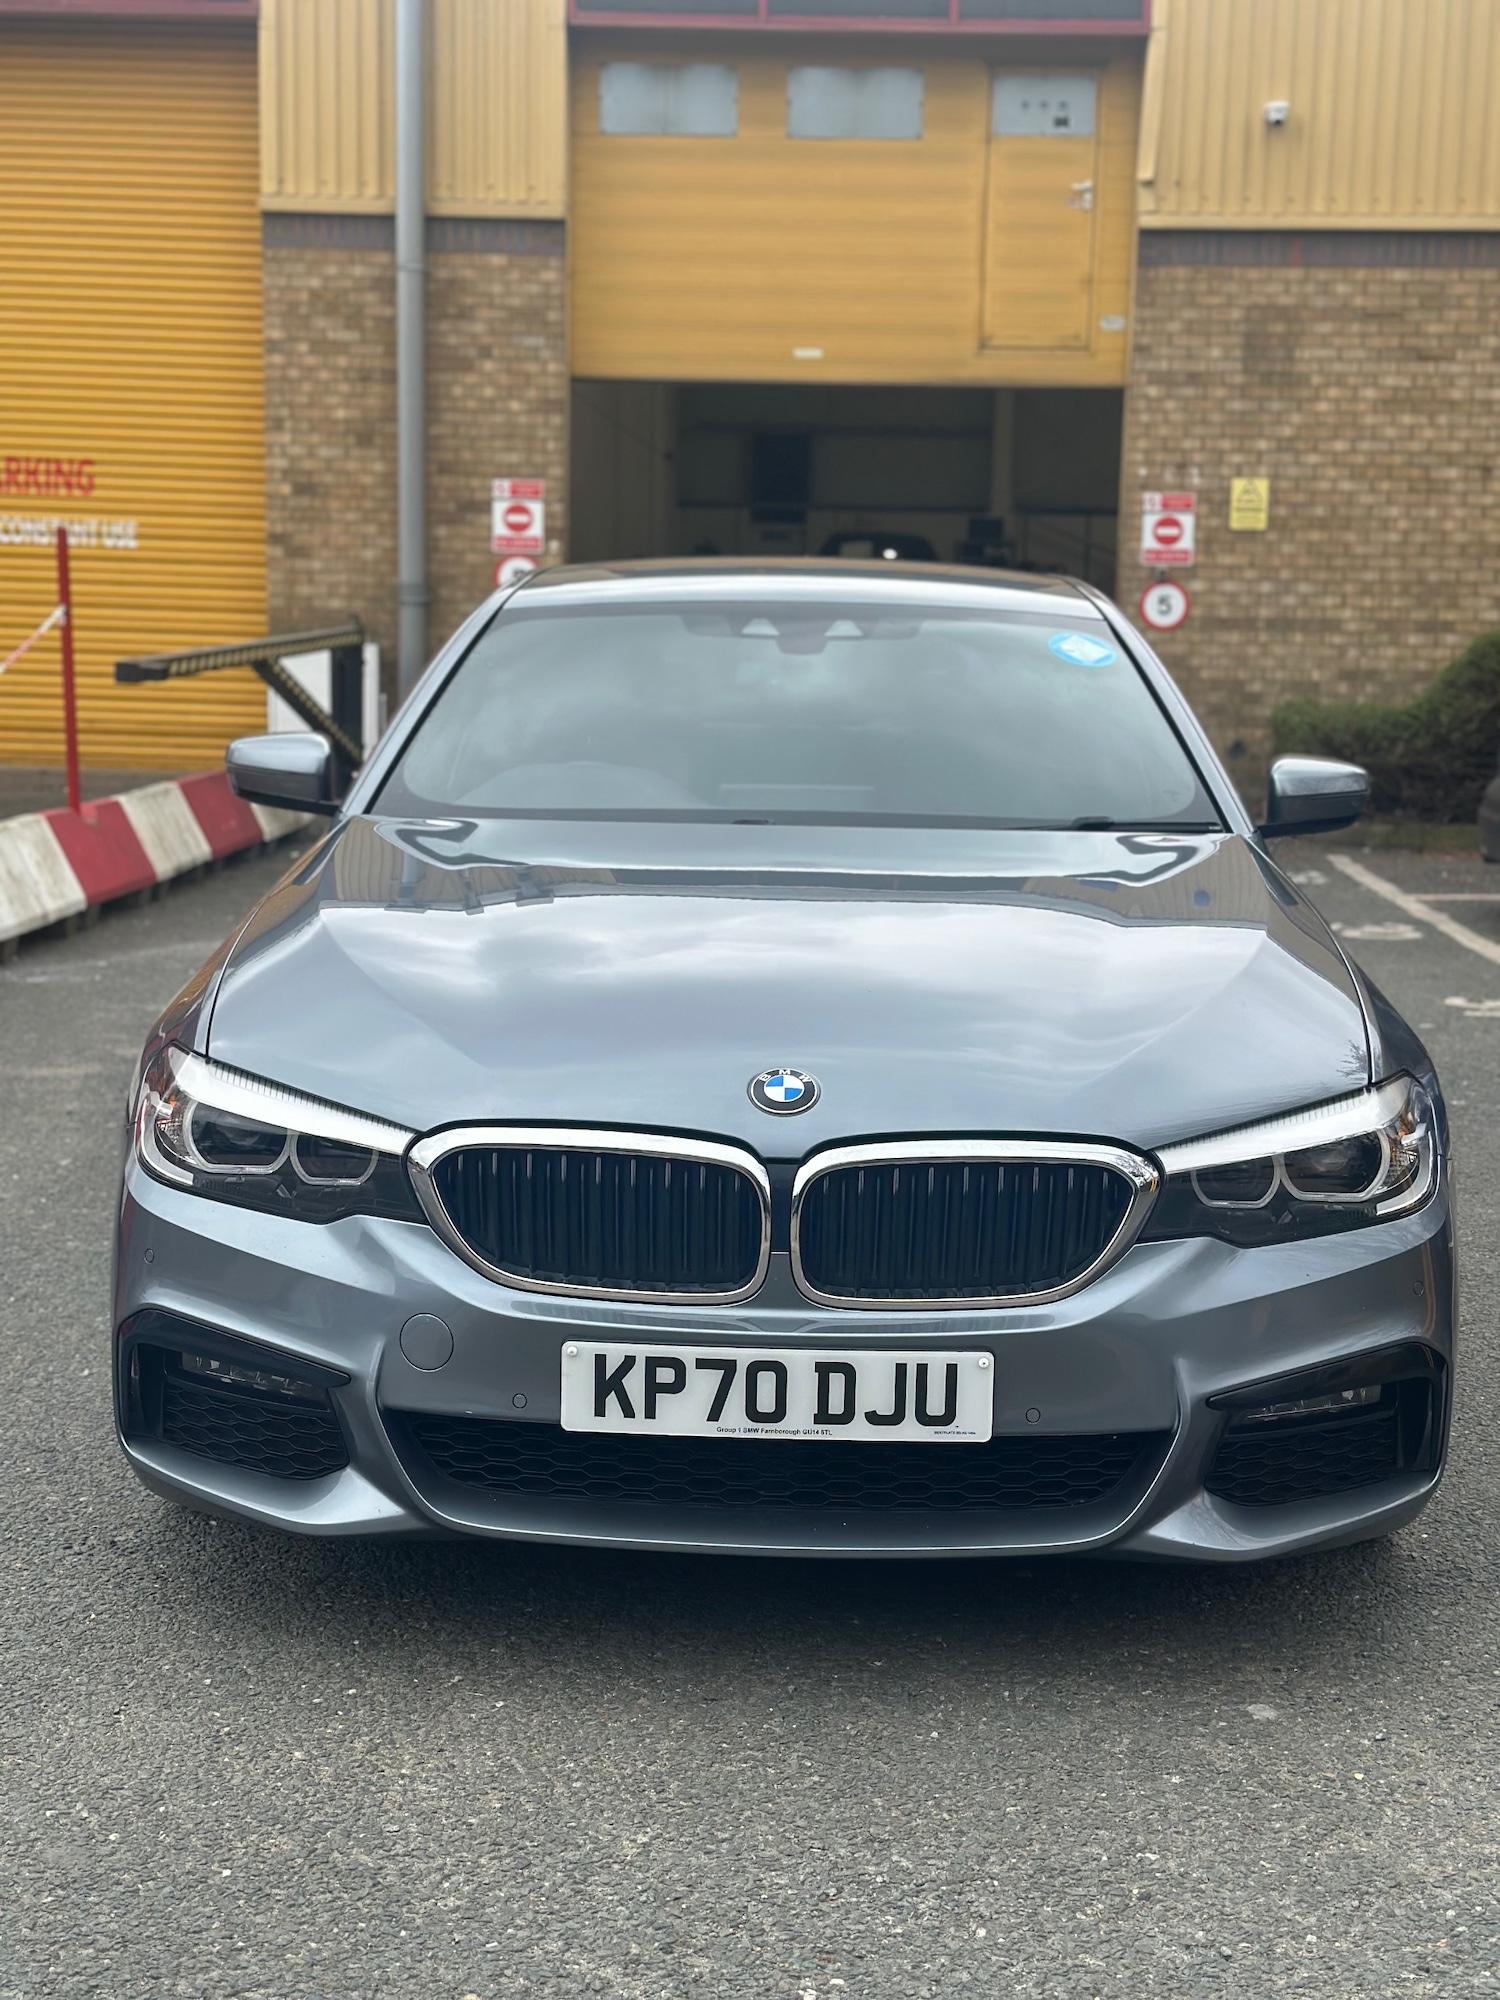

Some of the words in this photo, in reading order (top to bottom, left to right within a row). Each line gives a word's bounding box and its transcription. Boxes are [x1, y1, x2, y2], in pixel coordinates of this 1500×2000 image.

[0, 456, 95, 496] RKING
[1157, 594, 1172, 616] 5
[759, 1069, 812, 1083] BMW
[594, 1354, 787, 1424] KP70
[814, 1361, 958, 1427] DJU
[716, 1426, 737, 1434] Group
[761, 1427, 801, 1436] Farnborough
